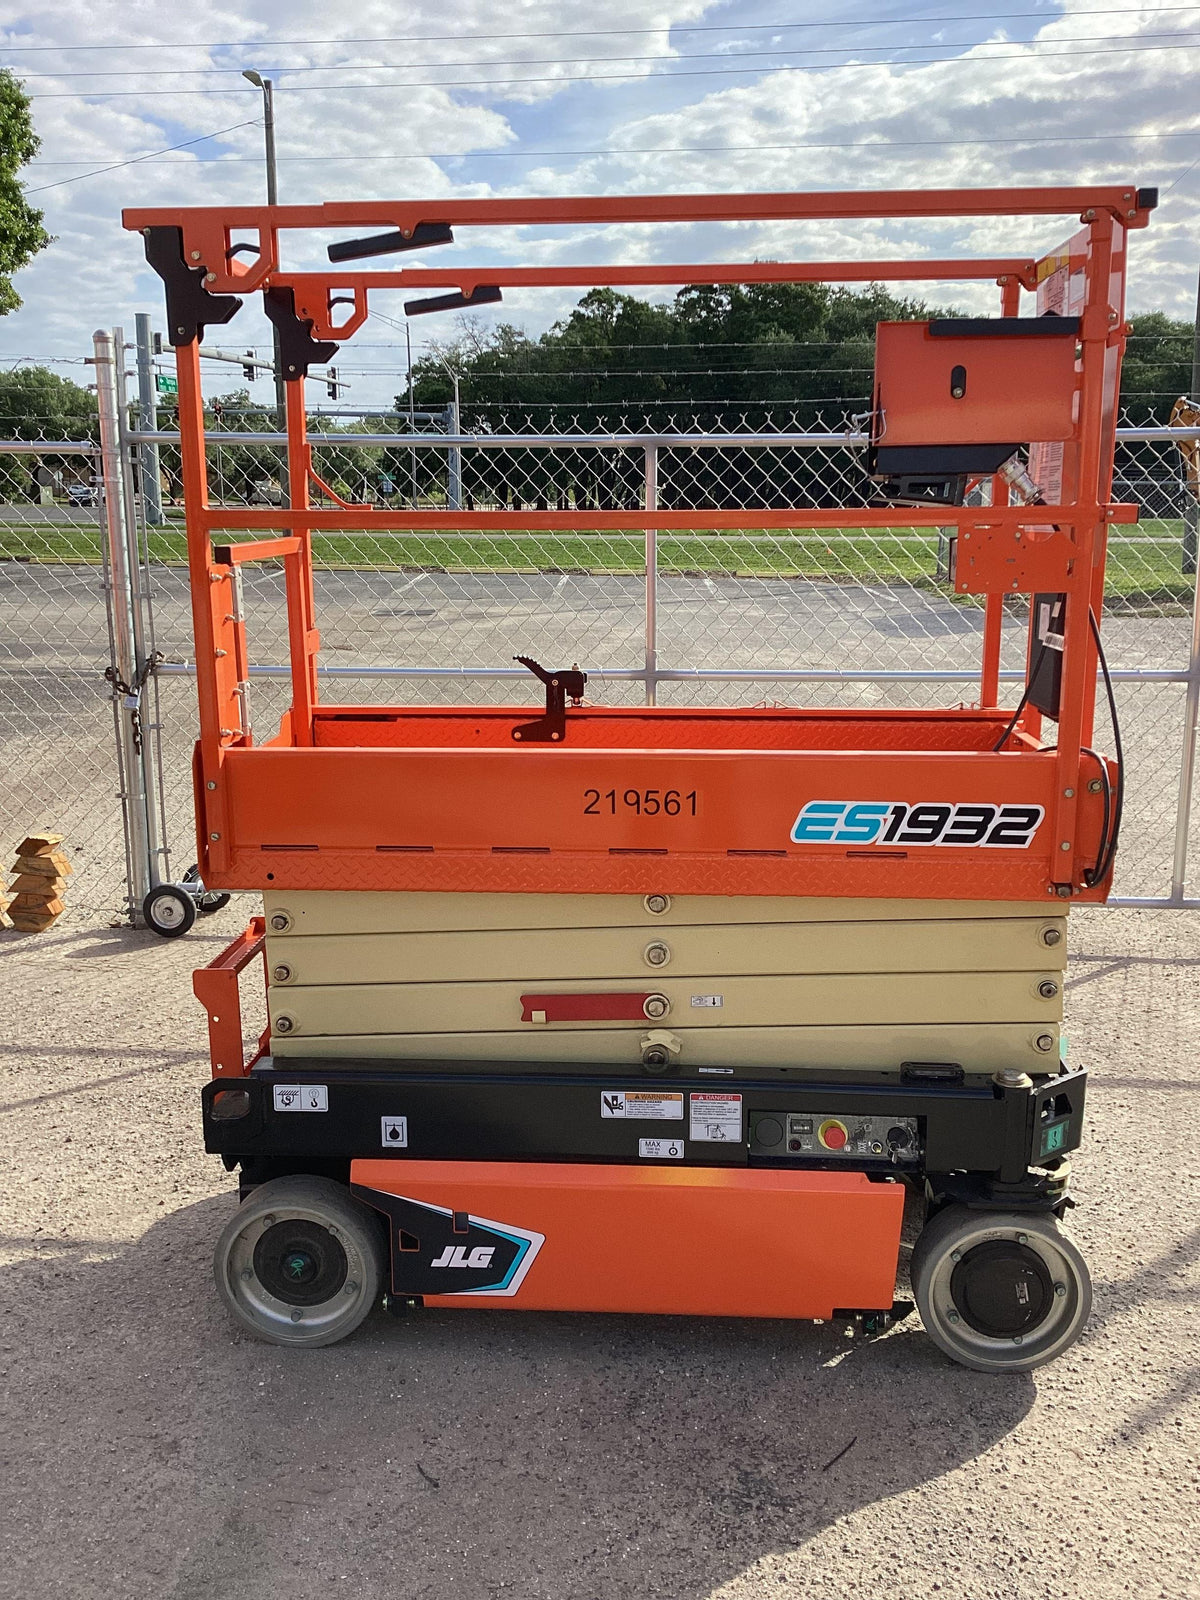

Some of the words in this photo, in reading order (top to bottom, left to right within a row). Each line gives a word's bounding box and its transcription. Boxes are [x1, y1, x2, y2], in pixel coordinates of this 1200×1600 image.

[583, 789, 697, 816] 219561
[794, 803, 1042, 846] ES1932
[431, 1245, 496, 1268] JLG
